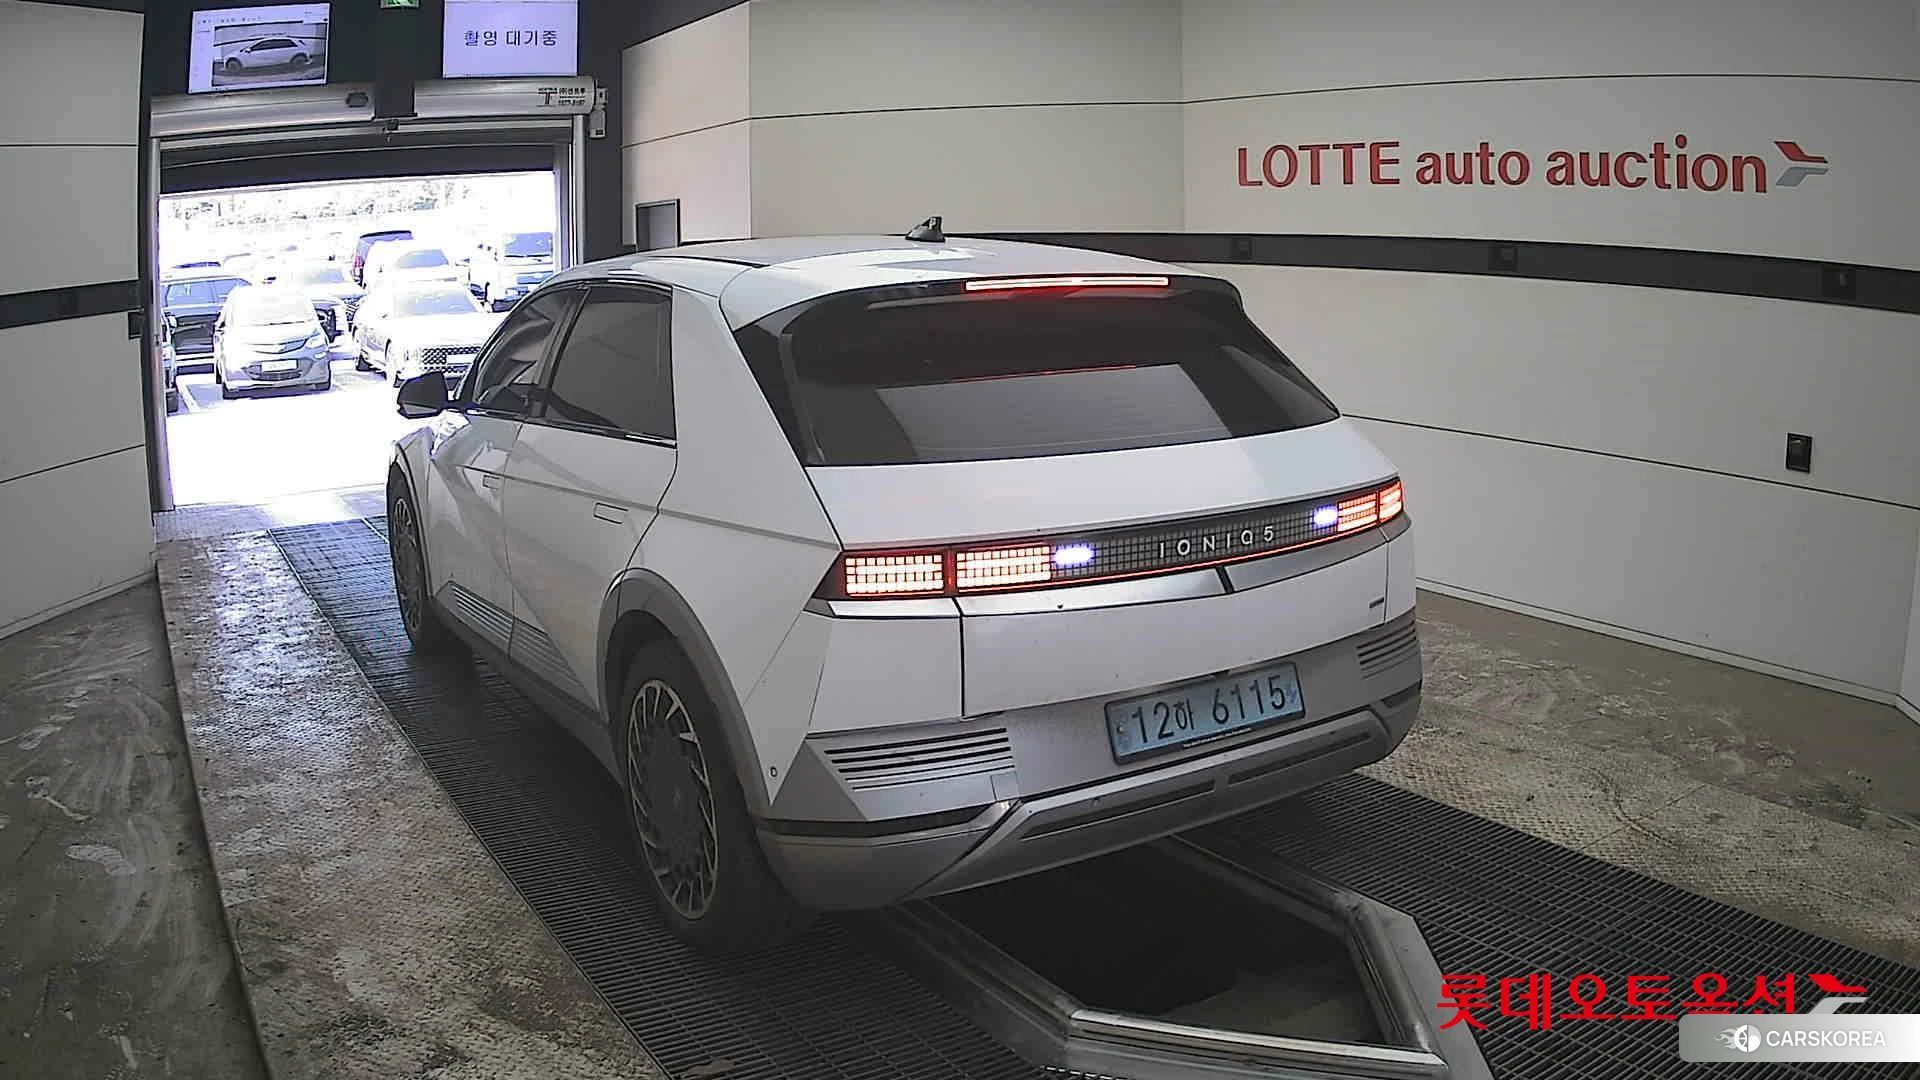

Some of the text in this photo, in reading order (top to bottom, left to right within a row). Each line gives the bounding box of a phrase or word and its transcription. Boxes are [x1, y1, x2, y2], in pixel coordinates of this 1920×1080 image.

[464, 30, 558, 47] 촬영 대기중
[1238, 134, 1768, 194] LOTTE auto auction
[1212, 675, 1286, 725] 6115
